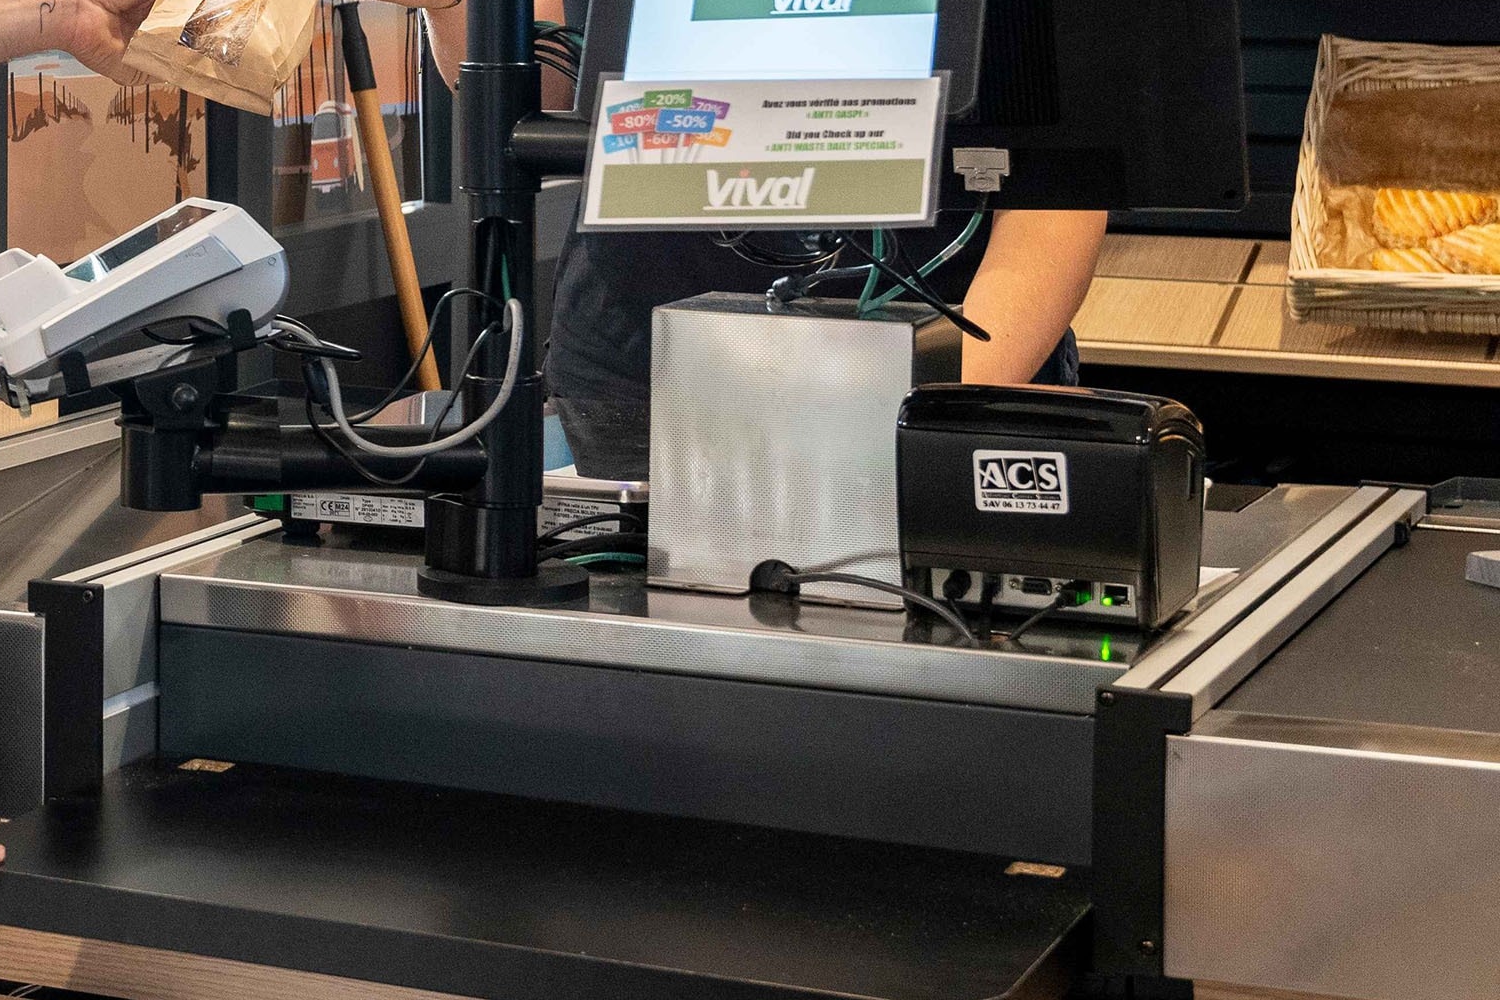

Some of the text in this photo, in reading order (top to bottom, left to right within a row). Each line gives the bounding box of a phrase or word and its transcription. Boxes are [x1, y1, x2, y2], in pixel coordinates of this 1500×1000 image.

[651, 94, 686, 105] -20%
[861, 98, 917, 108] promotions
[619, 114, 657, 128] -80%
[665, 115, 708, 128] -50%
[979, 462, 1058, 490] ACS
[982, 500, 1000, 508] SAV
